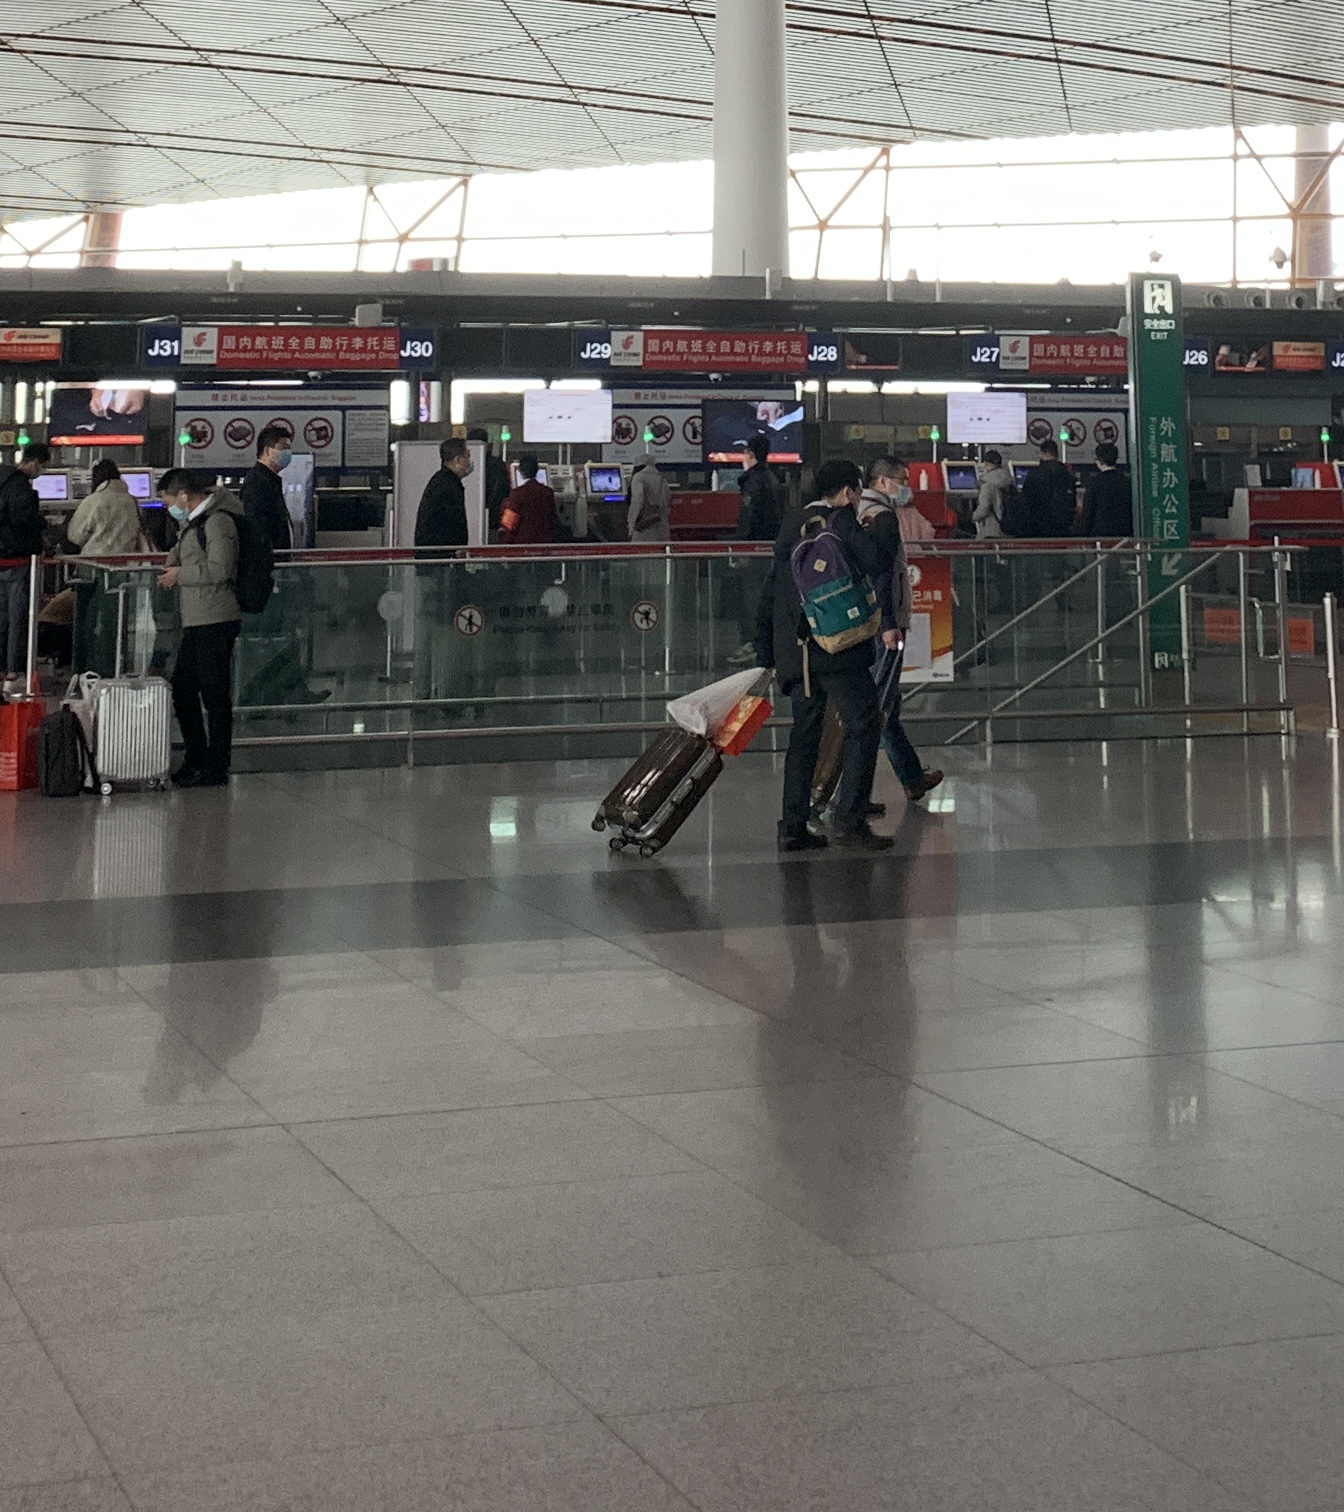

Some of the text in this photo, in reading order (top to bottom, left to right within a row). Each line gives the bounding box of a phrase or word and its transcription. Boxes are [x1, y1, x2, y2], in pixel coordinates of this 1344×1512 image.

[147, 339, 179, 356] J31
[221, 334, 397, 350] 国内航班全自助行李托运
[400, 341, 433, 357] J30
[579, 342, 612, 359] J29
[647, 338, 802, 354] 国内航班全自助行李托运
[807, 345, 838, 362] J28
[971, 346, 1000, 363] J27
[1182, 350, 1208, 365] J26
[1160, 416, 1180, 540] 外航办公区
